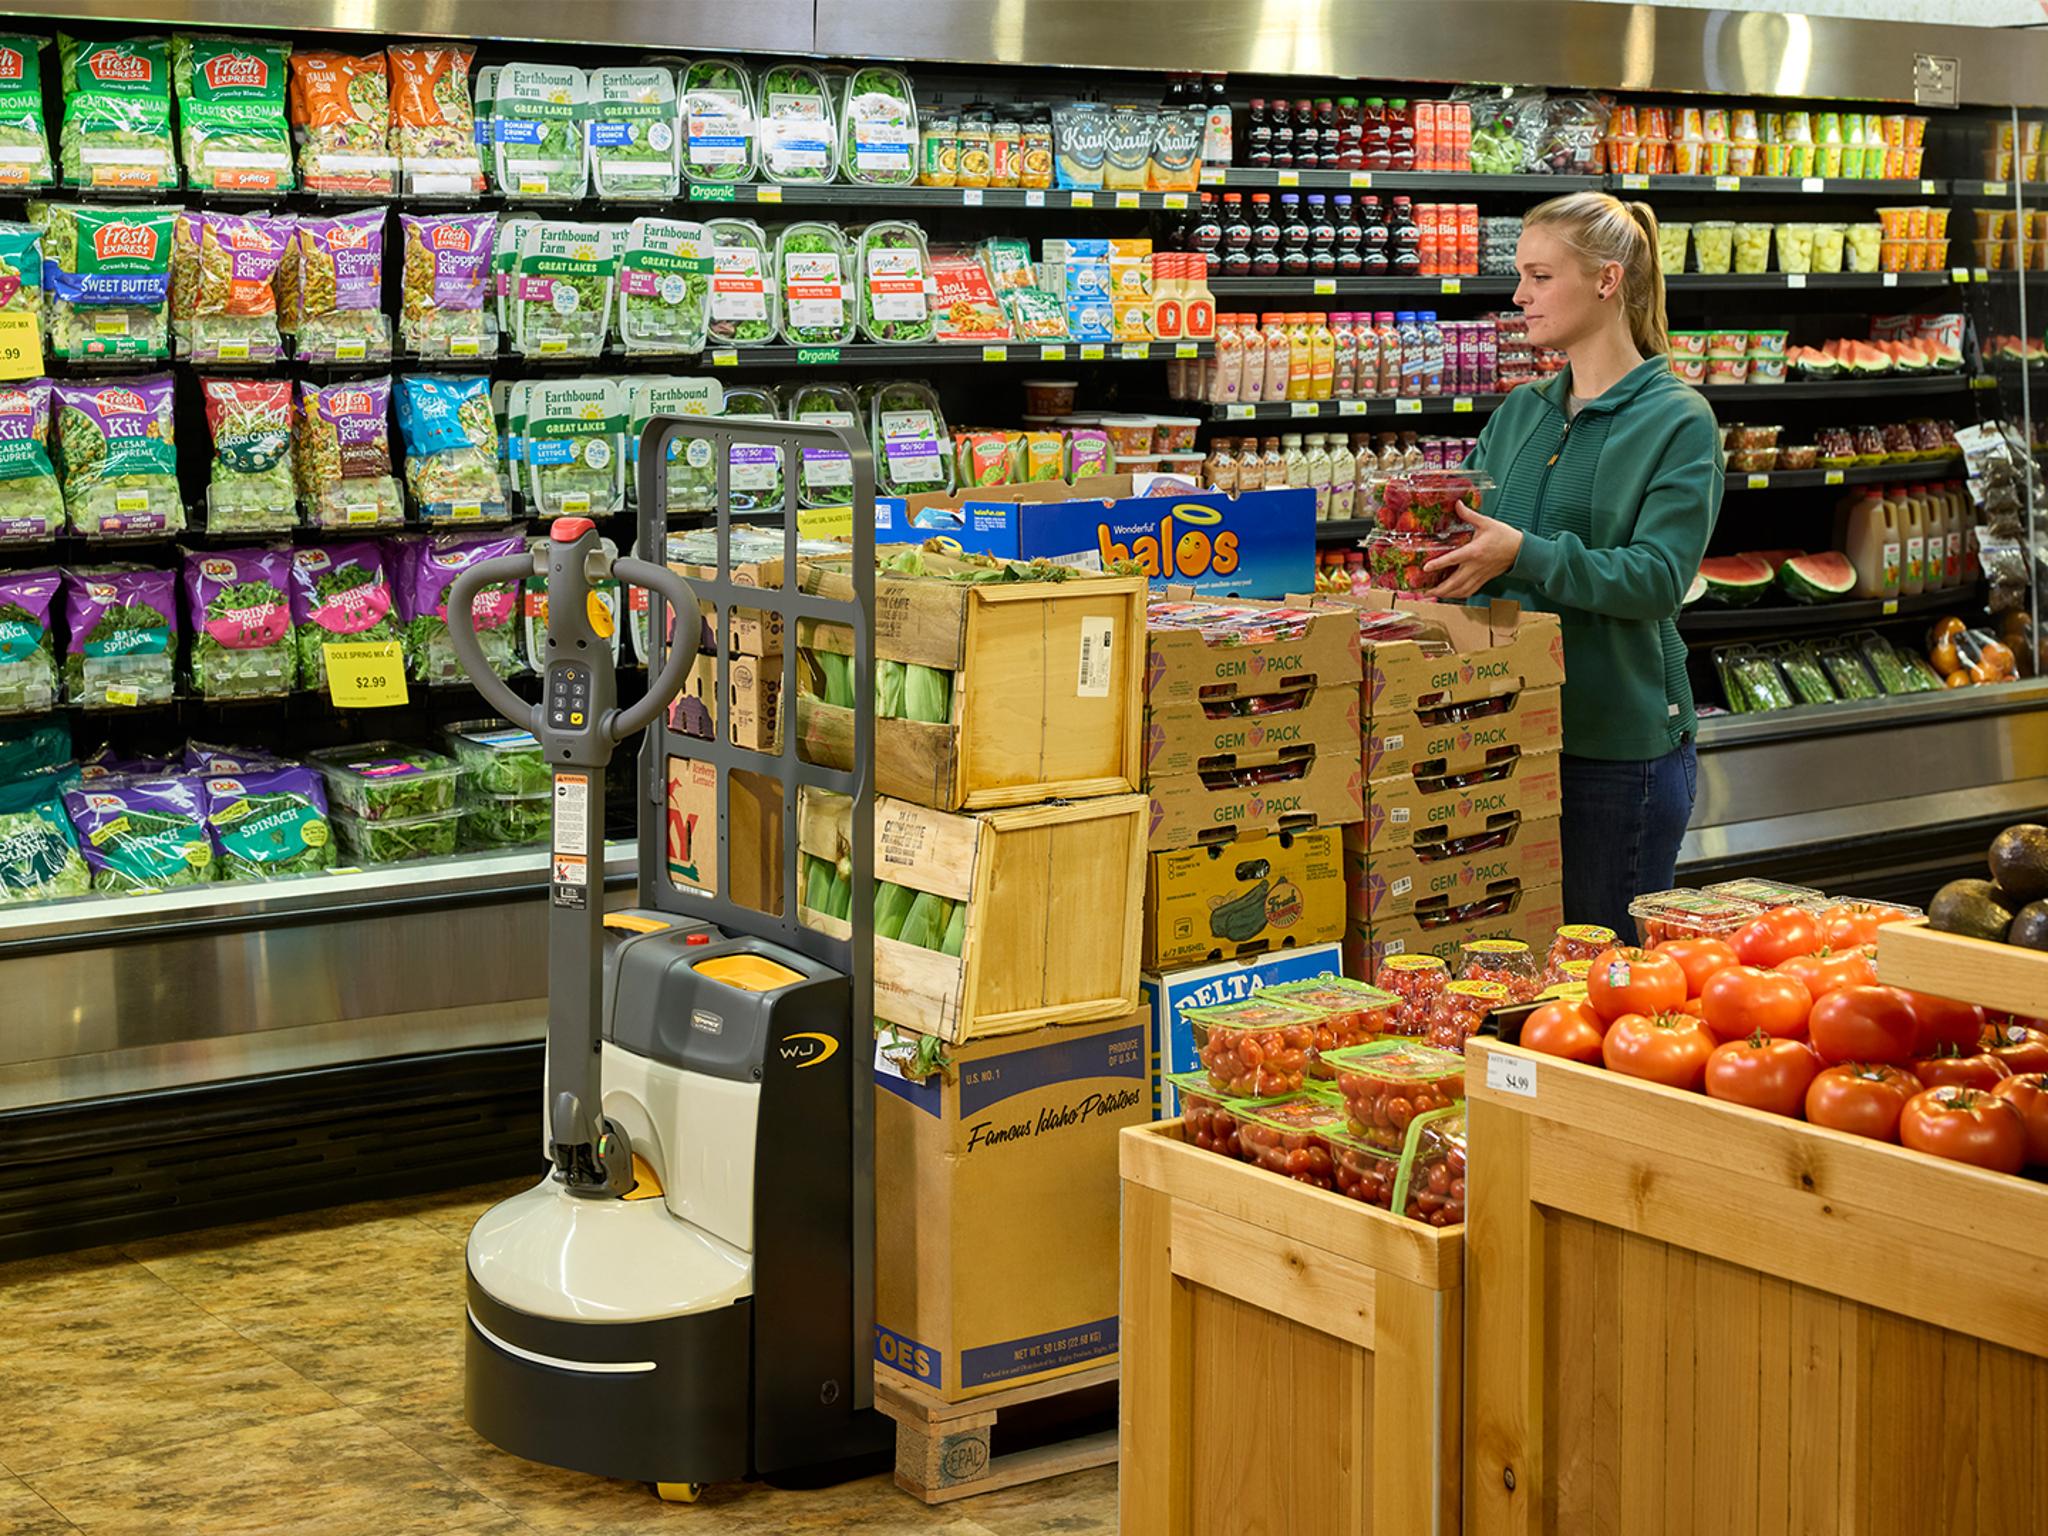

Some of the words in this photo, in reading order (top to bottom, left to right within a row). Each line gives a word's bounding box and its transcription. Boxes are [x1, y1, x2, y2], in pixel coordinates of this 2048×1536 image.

[98, 53, 144, 71] Fresh
[214, 57, 259, 75] Fresh
[214, 75, 261, 85] EXPRESS
[514, 71, 573, 86] Earthbound
[603, 74, 660, 86] Earthbound
[514, 85, 540, 97] Farm
[603, 87, 629, 99] Farm
[514, 104, 543, 114] GREAT
[545, 105, 573, 116] LAKES
[604, 107, 632, 115] GREAT
[634, 105, 662, 115] LAKES
[1105, 126, 1153, 151] Kraut
[1152, 127, 1200, 152] Kraut
[690, 184, 735, 201] Organic
[103, 226, 150, 246] Fresh
[437, 229, 466, 241] Fresh
[541, 228, 600, 243] Earthbound
[644, 223, 702, 241] Earthbound
[103, 244, 150, 255] EXPRESS
[540, 243, 566, 255] Farm
[643, 238, 668, 250] Farm
[237, 264, 256, 277] Kit
[339, 264, 357, 274] Kit
[439, 263, 456, 274] Kit
[538, 262, 566, 272] GREAT
[567, 262, 597, 273] LAKES
[641, 256, 670, 267] GREAT
[670, 260, 699, 271] LAKES
[81, 277, 119, 293] SWEET
[122, 278, 163, 294] BUTTER
[439, 281, 463, 290] ASIAN
[797, 348, 840, 364] Organic
[545, 389, 605, 402] Earthbound
[650, 386, 708, 400] Earthbound
[545, 404, 572, 416] Farm
[650, 402, 676, 413] Farm
[107, 418, 142, 438] Kit
[341, 428, 361, 440] Kit
[546, 422, 576, 434] GREAT
[577, 421, 606, 432] LAKES
[111, 439, 147, 450] CAESAR
[1113, 523, 1155, 536] Wonderful
[1097, 514, 1241, 578] halos
[205, 562, 234, 576] Dole
[327, 585, 376, 609] SPRING
[473, 591, 501, 609] RING
[226, 602, 275, 623] SPRING
[345, 599, 366, 613] MIX
[103, 633, 153, 654] SPINACH
[331, 652, 348, 660] DOLE
[349, 651, 372, 659] SPRING
[1216, 662, 1246, 678] GEM
[1267, 656, 1303, 672] PACK
[1432, 672, 1459, 688] GEM
[1477, 661, 1510, 679] PACK
[355, 675, 386, 689] $2.99
[1214, 733, 1246, 750] GEM
[1266, 725, 1301, 742] PACK
[1428, 738, 1456, 755] GEM
[1474, 728, 1507, 746] PACK
[1214, 805, 1245, 822] GEM
[1265, 796, 1302, 815] PACK
[1428, 806, 1456, 822] GEM
[1474, 794, 1507, 813] PACK
[239, 808, 300, 838] SPINACH
[1430, 875, 1458, 892] GEM
[1476, 862, 1508, 881] PACK
[780, 1043, 814, 1058] WJ
[1108, 1038, 1139, 1055] PRODUCE
[1108, 1055, 1118, 1067] OF
[968, 1119, 1032, 1153] Famous
[1035, 1104, 1078, 1138] Idaho
[1078, 1087, 1141, 1120] Potatoes
[1014, 1347, 1029, 1361] NET
[1043, 1341, 1053, 1354] 50
[1054, 1338, 1067, 1352] LBS
[950, 1443, 982, 1472] EPAL
